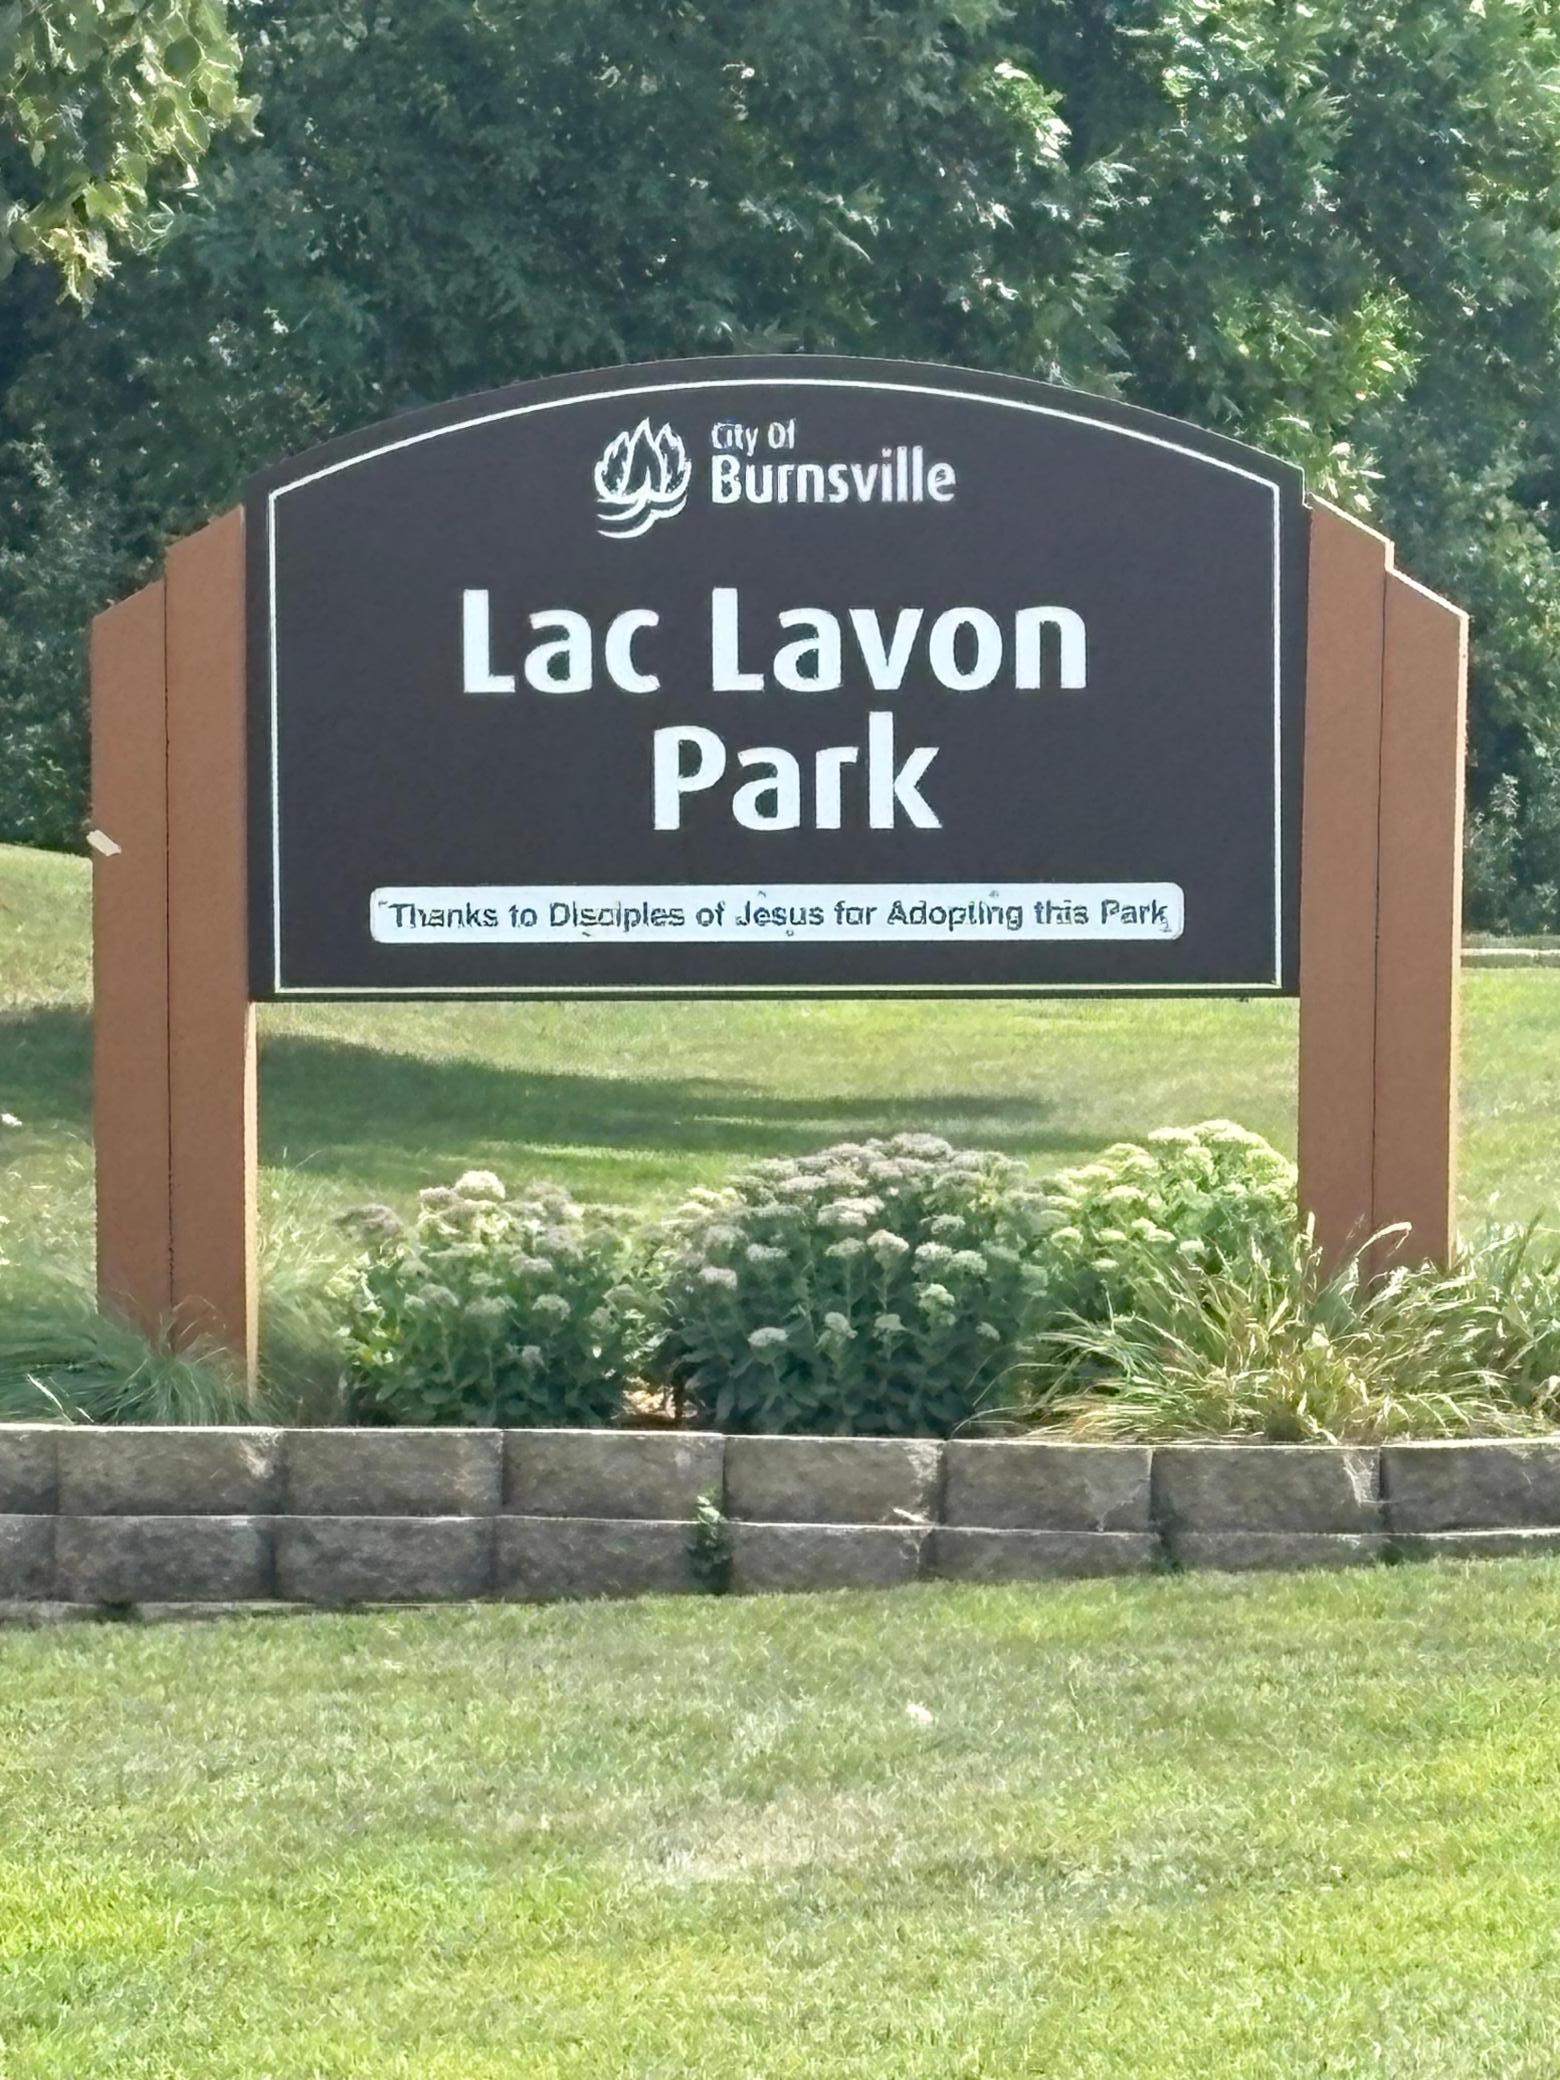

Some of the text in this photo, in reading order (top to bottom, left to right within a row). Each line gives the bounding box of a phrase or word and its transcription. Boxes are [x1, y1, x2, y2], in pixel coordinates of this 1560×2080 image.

[711, 421, 759, 456] City
[711, 446, 957, 505] Burnsville
[462, 587, 1087, 695] Lac Lavon
[653, 711, 943, 832] Park
[388, 899, 1168, 932] Thanks to Disciples of Jesus for Adopting this Park
